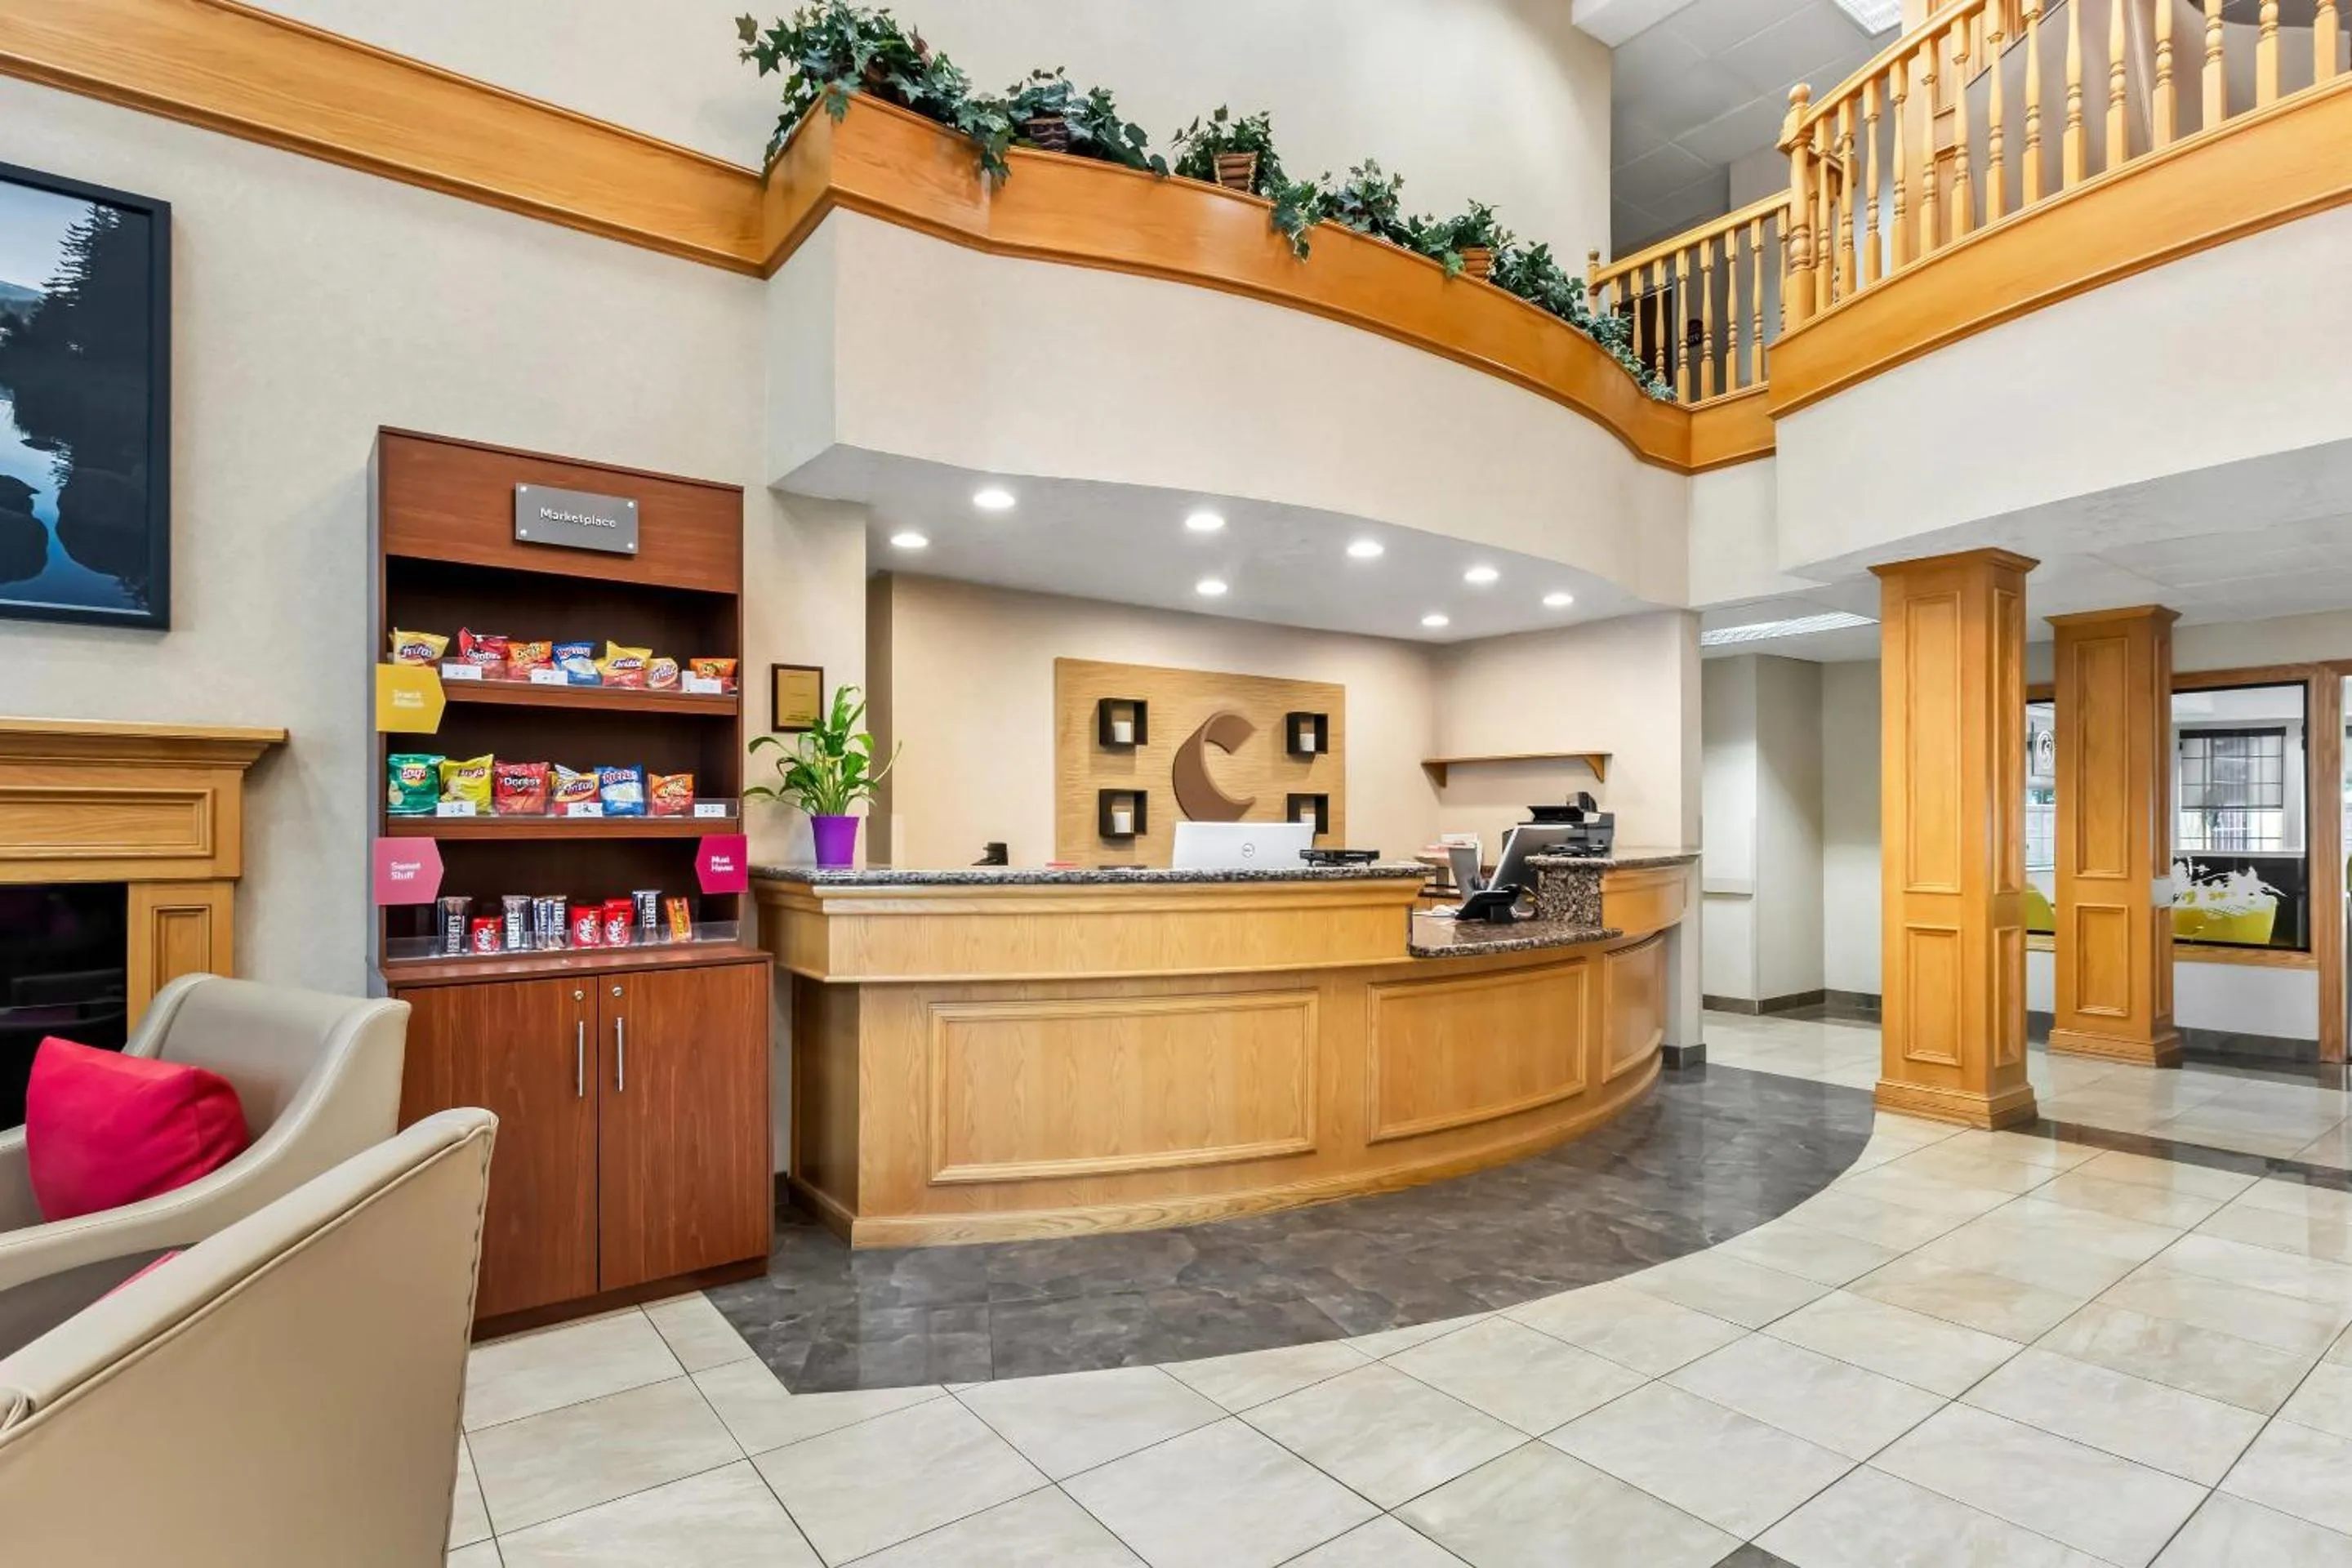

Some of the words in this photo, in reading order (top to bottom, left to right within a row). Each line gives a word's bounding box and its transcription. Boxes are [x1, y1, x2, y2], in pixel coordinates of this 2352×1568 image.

[540, 507, 617, 528] Marketplace
[503, 776, 540, 789] Doritos
[390, 871, 415, 880] Stuff
